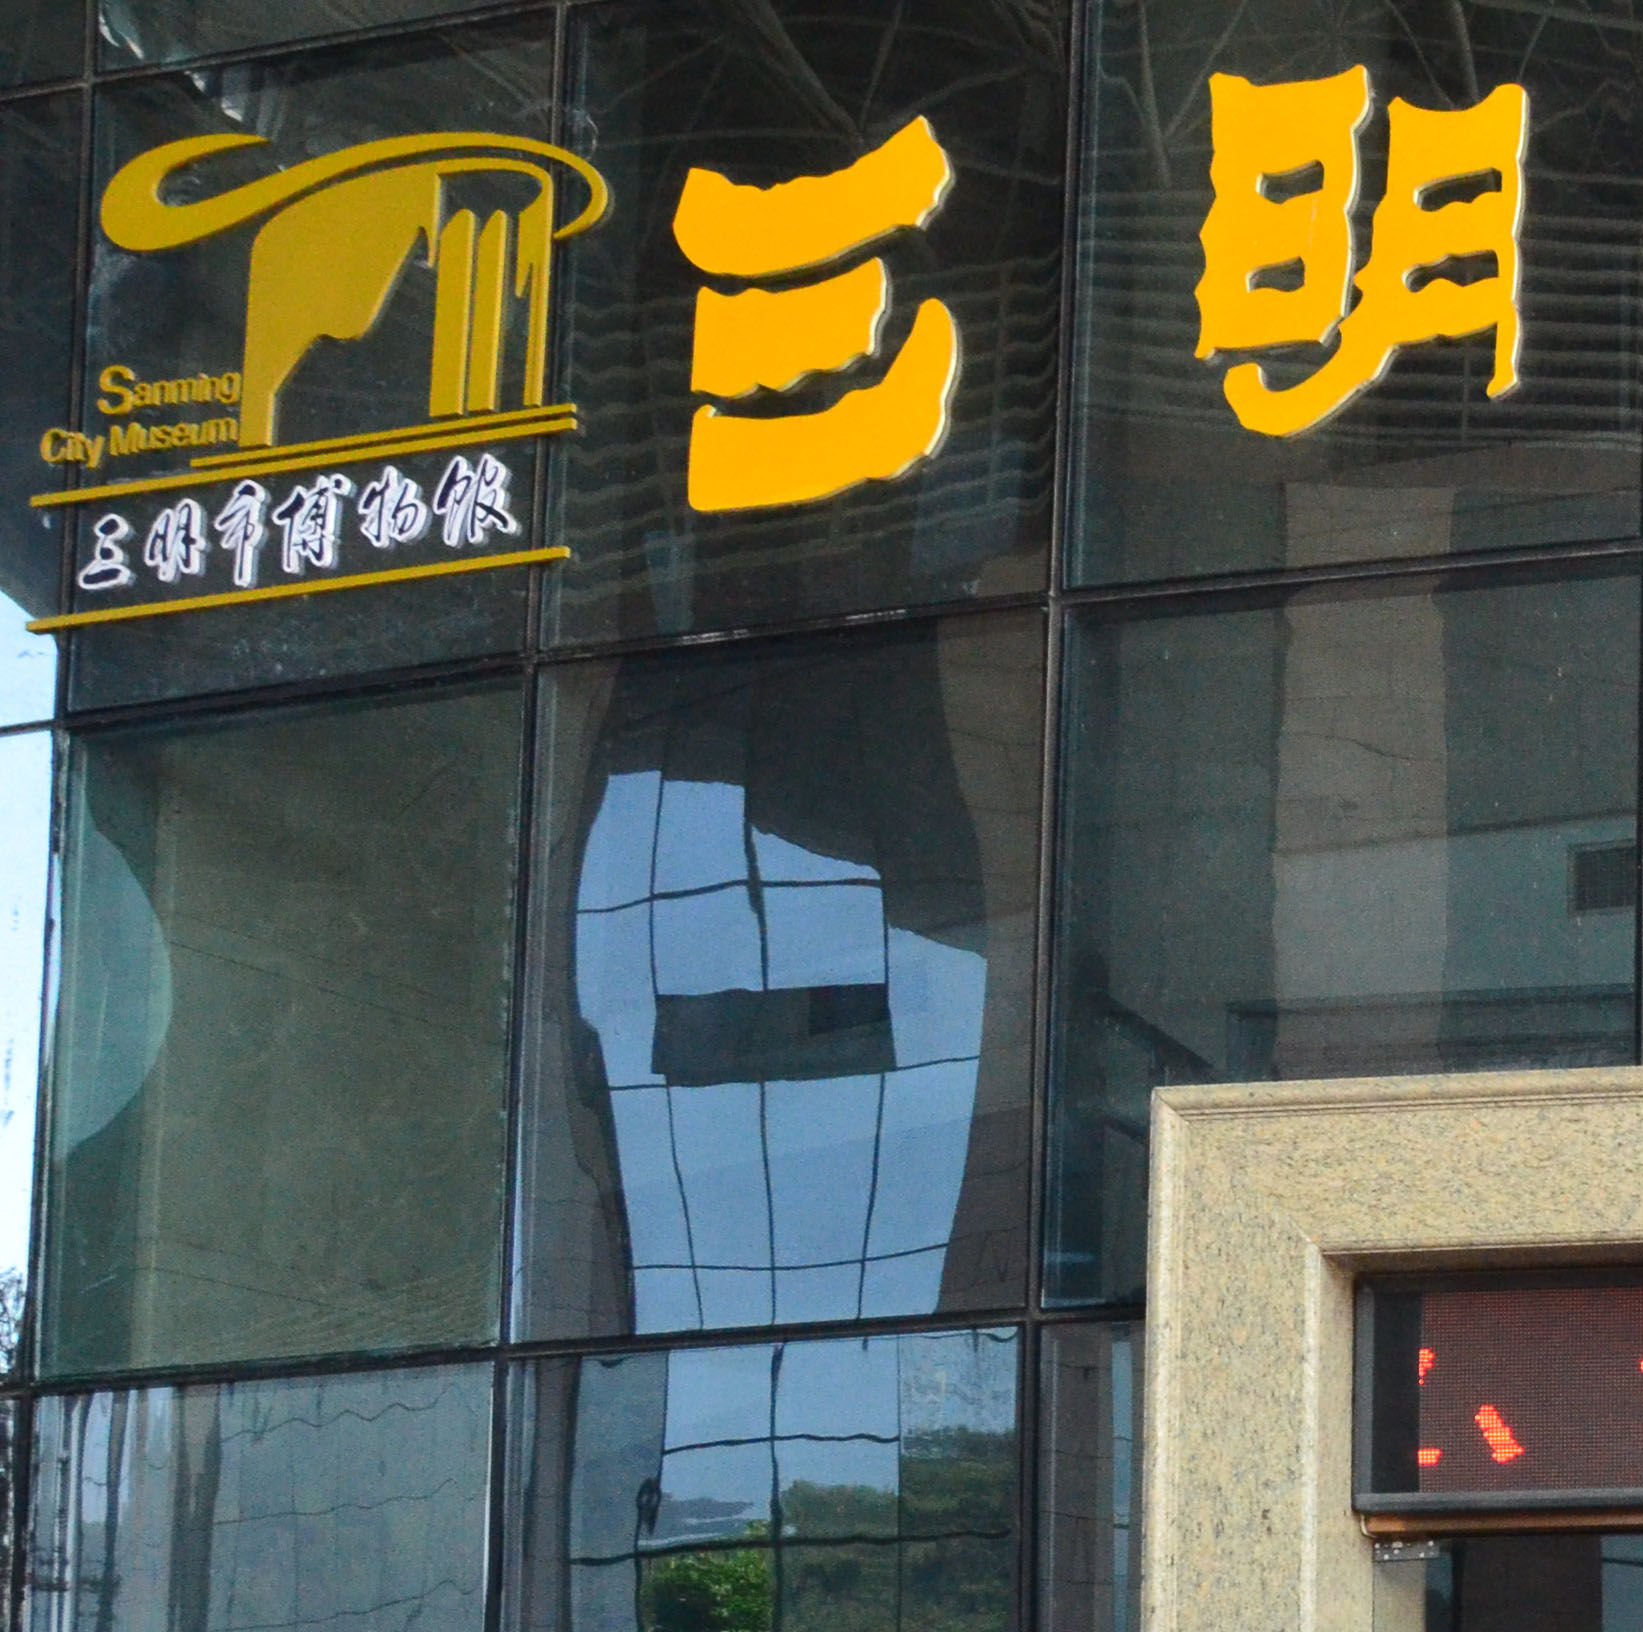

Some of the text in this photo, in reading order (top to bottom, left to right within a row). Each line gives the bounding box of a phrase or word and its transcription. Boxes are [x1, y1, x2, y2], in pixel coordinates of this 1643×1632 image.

[98, 365, 242, 416] Sanming
[40, 415, 242, 468] City Museum
